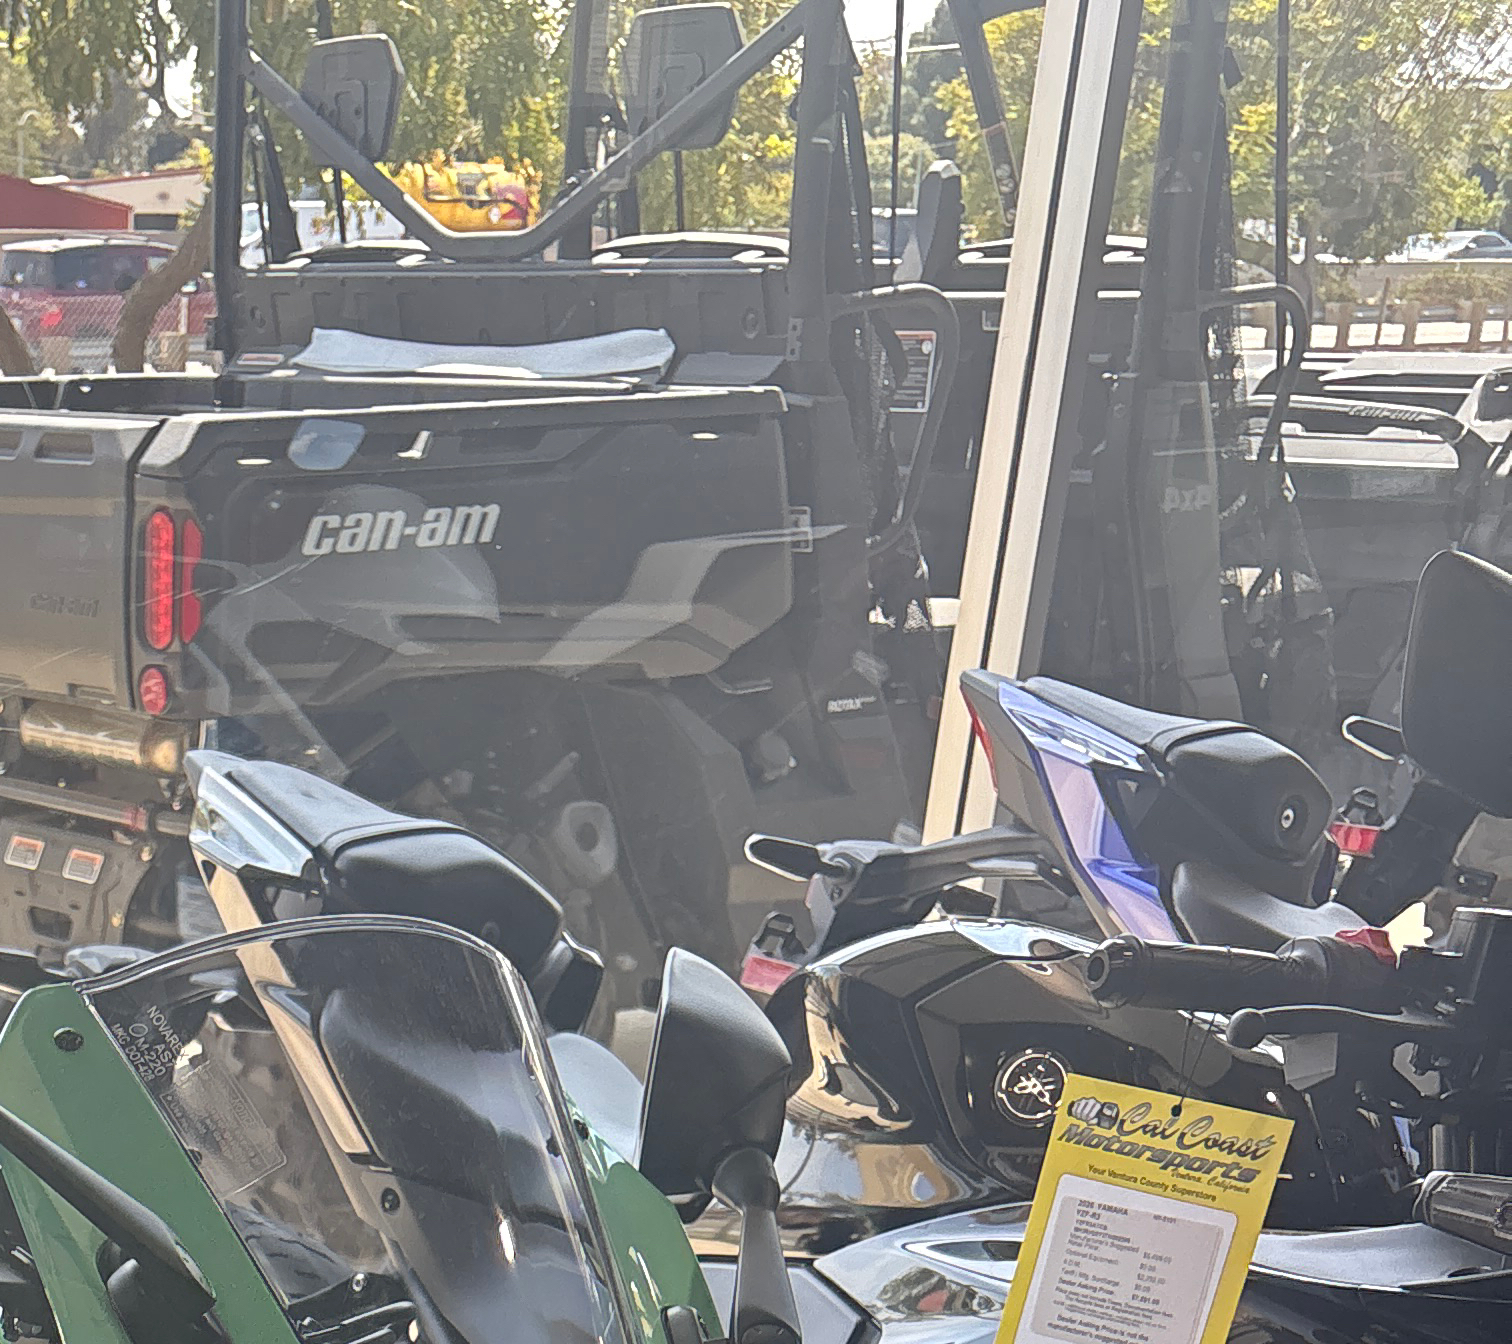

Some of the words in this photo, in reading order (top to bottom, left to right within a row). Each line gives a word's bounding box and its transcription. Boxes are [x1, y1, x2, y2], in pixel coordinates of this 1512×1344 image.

[301, 503, 501, 556] can-am
[135, 1037, 166, 1077] M-220
[1057, 1123, 1261, 1184] Motorsports
[1116, 1102, 1181, 1137] Cal
[1175, 1115, 1277, 1161] Coast
[1088, 1164, 1107, 1177] Your
[1107, 1168, 1138, 1184] Ventura
[1139, 1176, 1170, 1193] County
[1170, 1183, 1217, 1203] Superstore
[1098, 1204, 1128, 1216] YAMAHA
